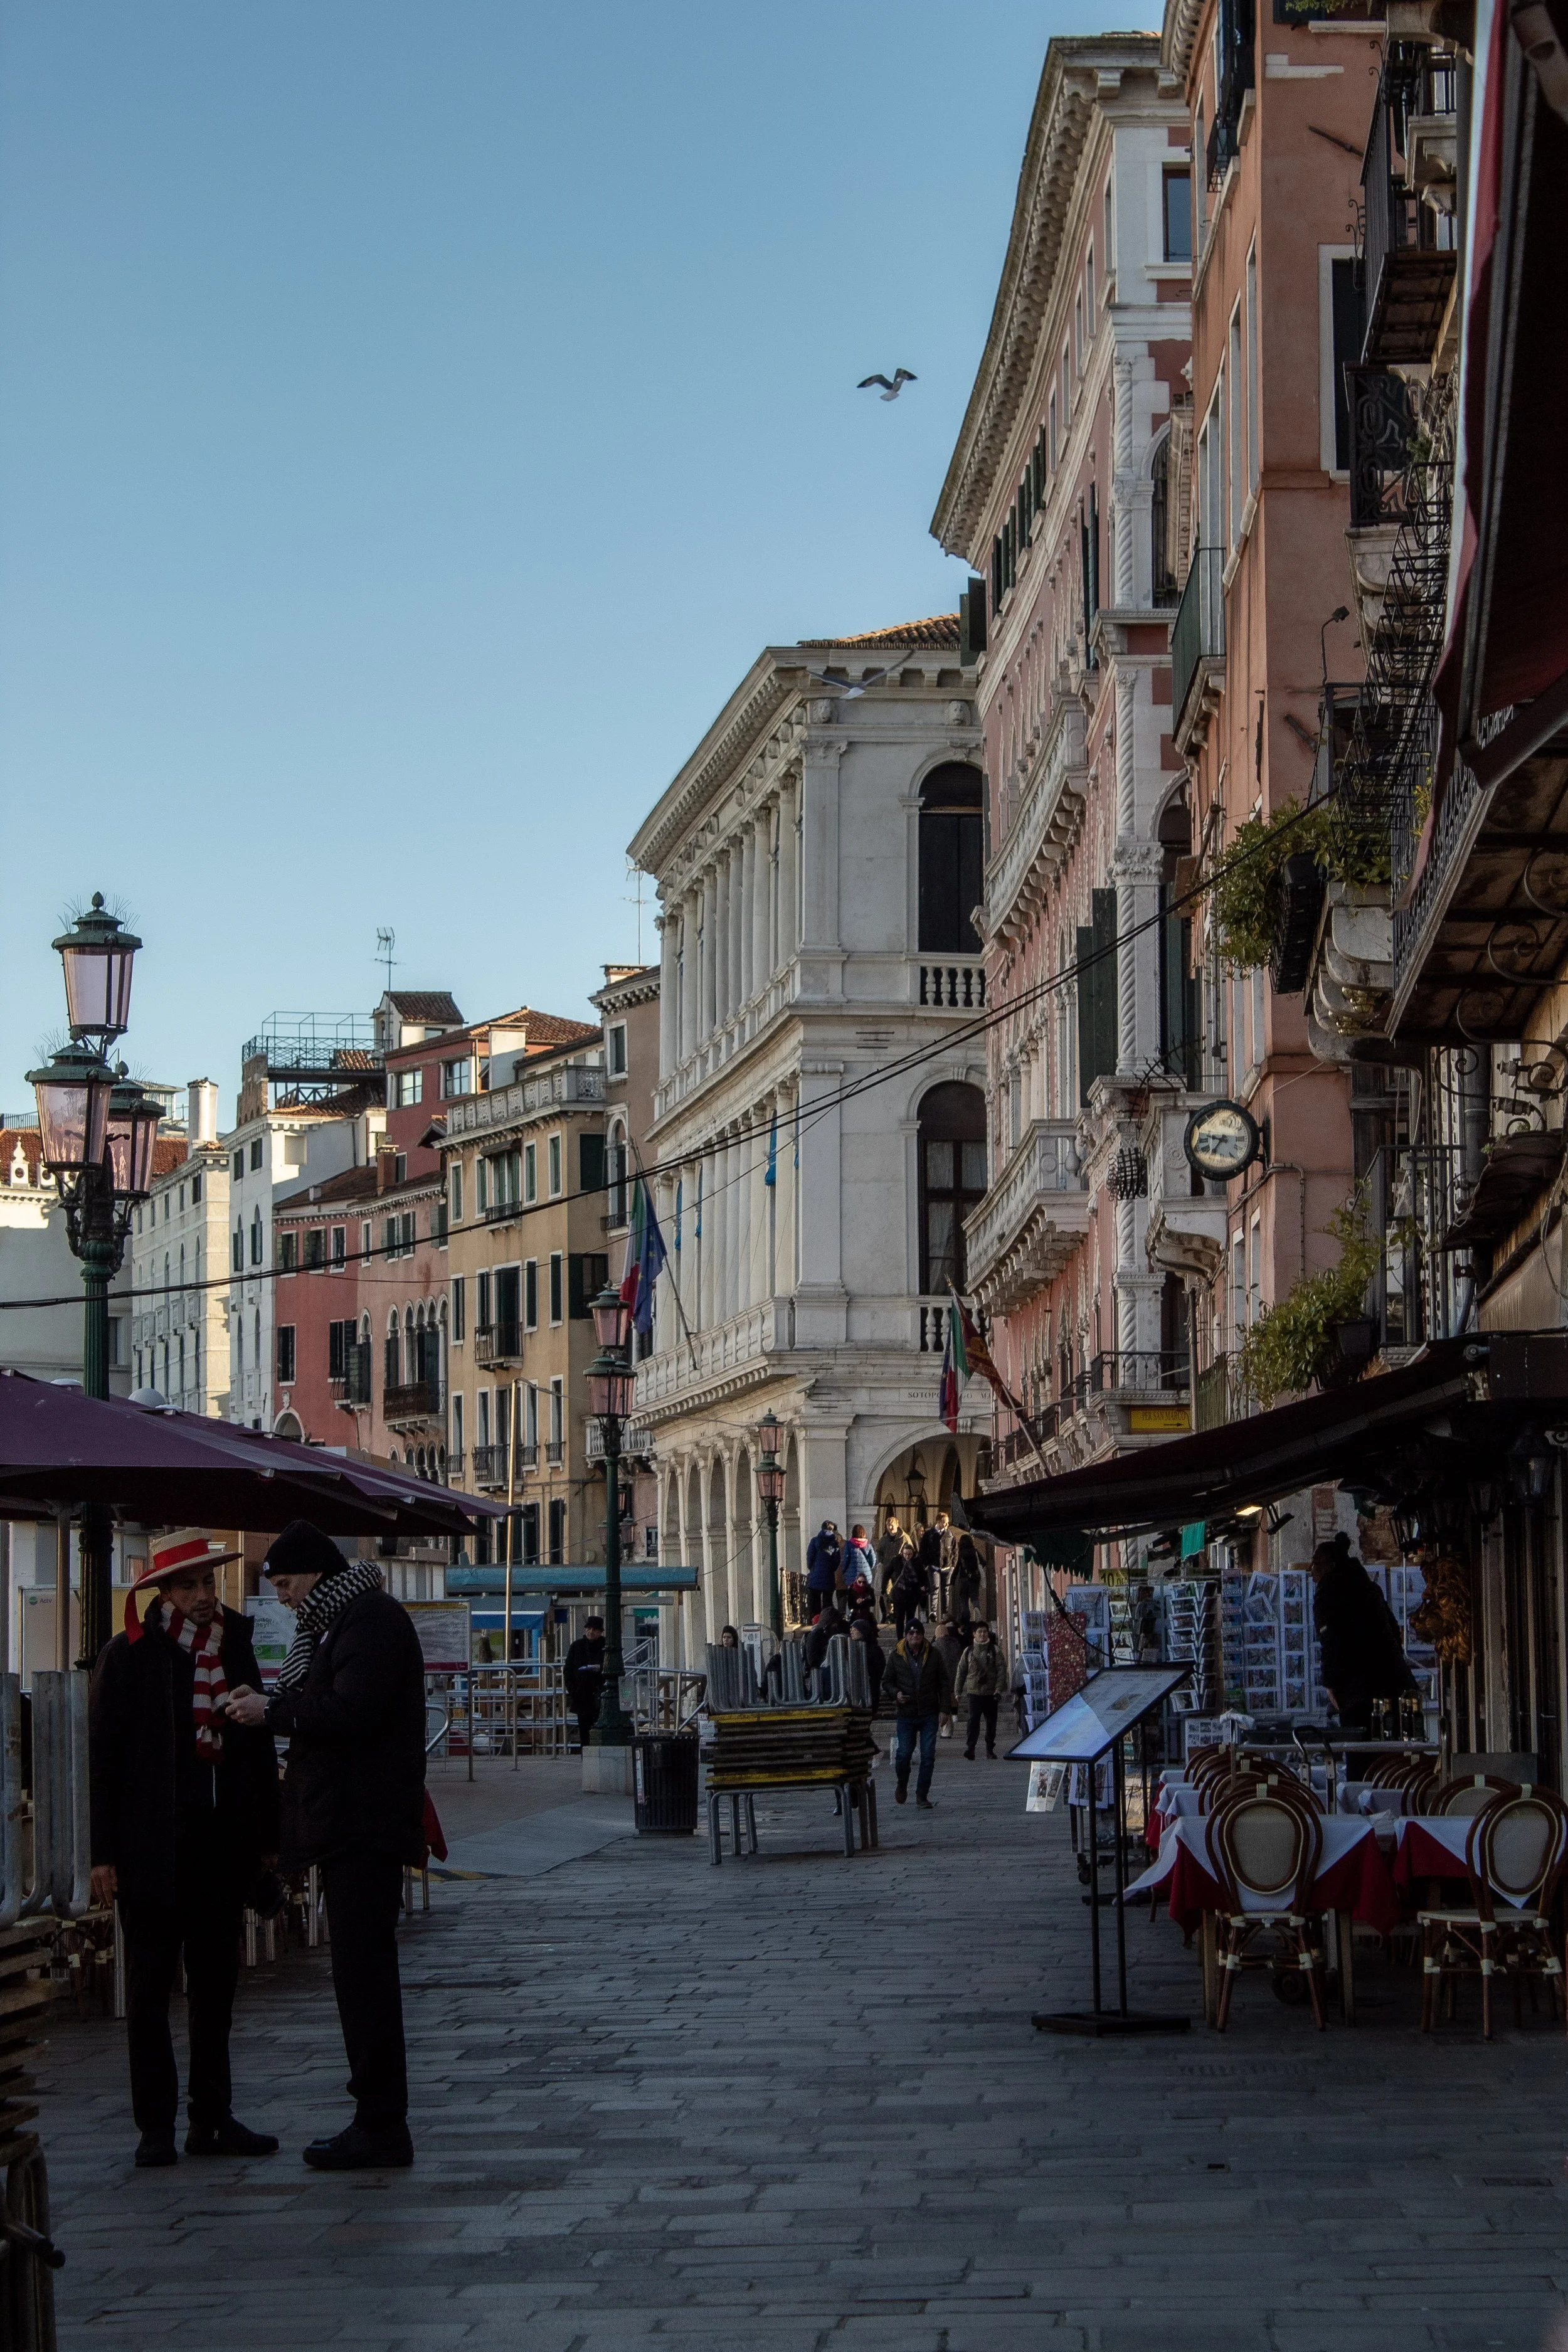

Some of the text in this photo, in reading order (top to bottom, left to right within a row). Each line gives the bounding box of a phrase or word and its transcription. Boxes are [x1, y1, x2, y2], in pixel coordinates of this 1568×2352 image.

[1142, 1411, 1186, 1421] PER SAN MARCO
